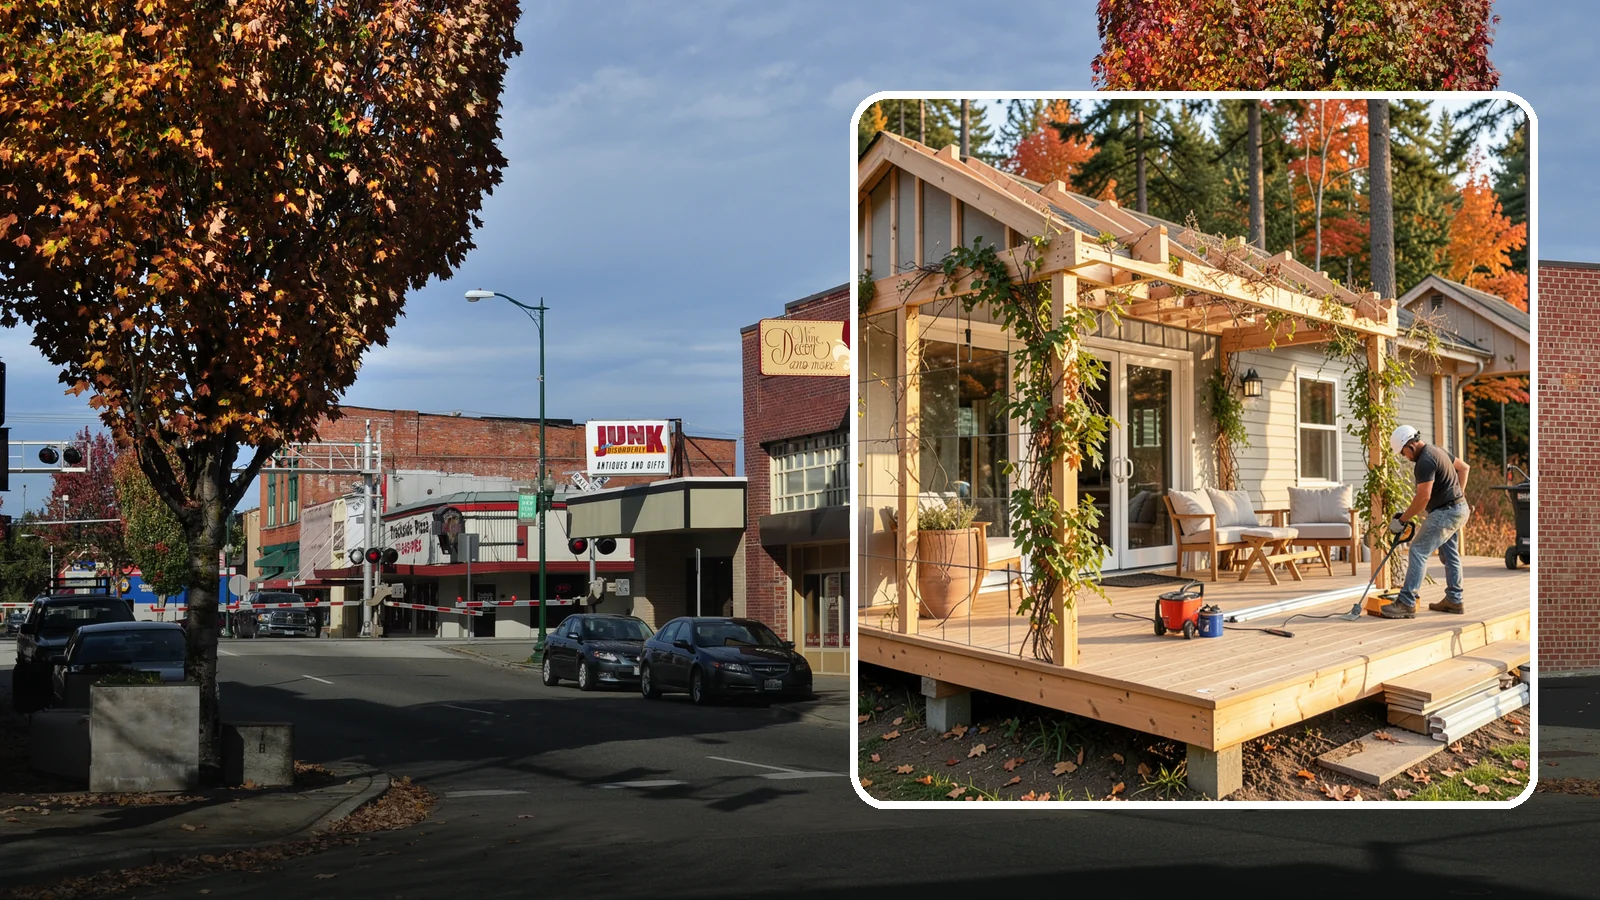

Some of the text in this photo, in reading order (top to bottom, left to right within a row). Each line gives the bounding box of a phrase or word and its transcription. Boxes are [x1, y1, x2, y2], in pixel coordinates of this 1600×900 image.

[595, 425, 665, 457] JUNK
[607, 446, 646, 454] DISORDERLY
[597, 460, 665, 470] ANTIQUES AND GIFTS
[390, 520, 429, 539] Trackside Pizza
